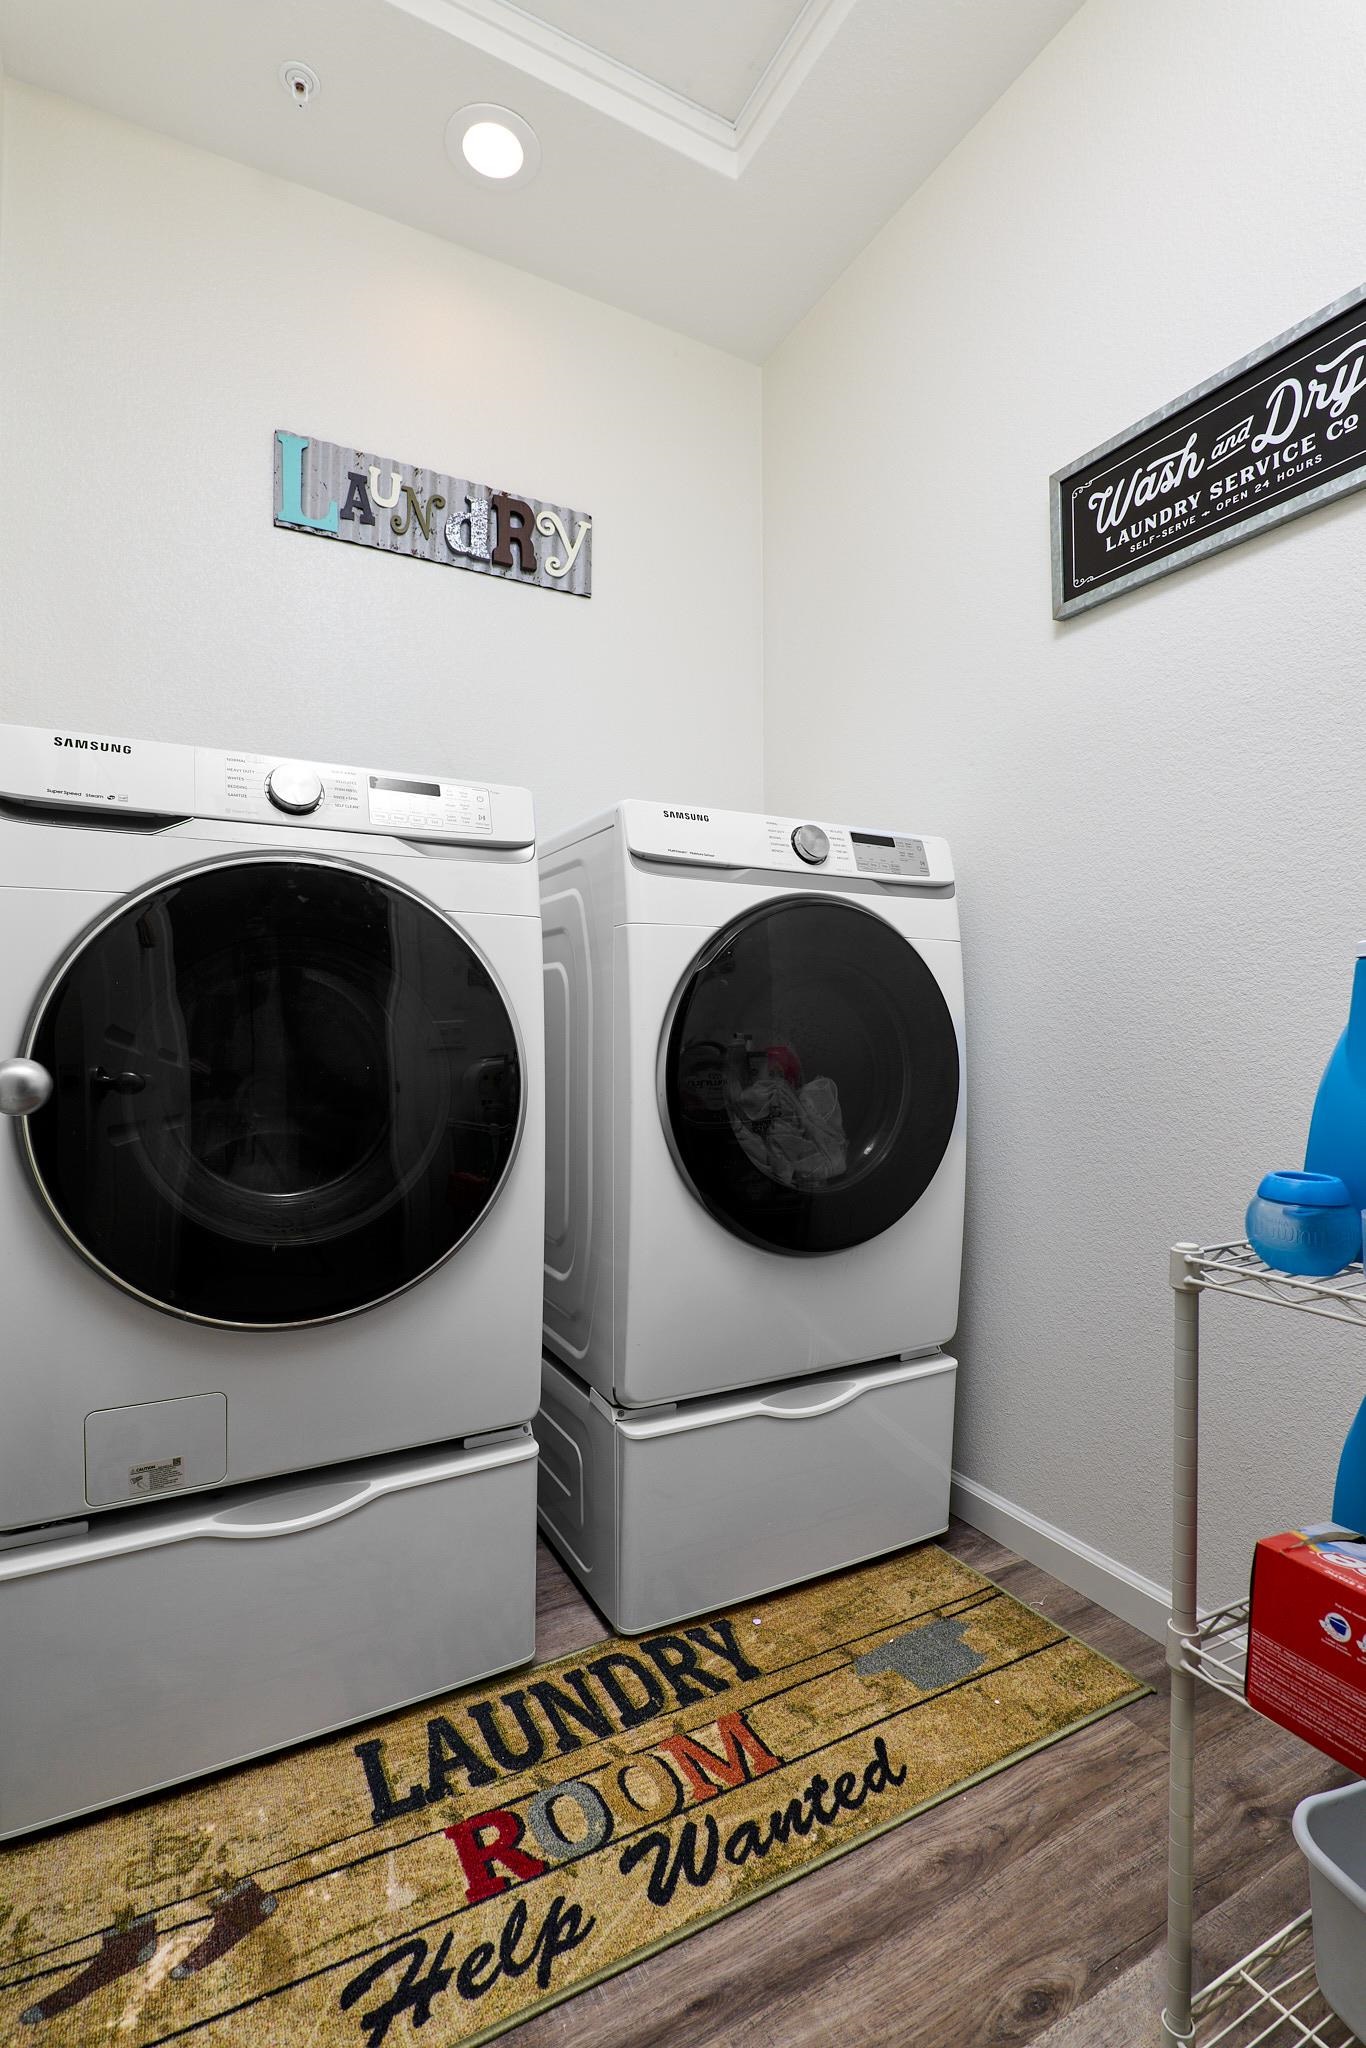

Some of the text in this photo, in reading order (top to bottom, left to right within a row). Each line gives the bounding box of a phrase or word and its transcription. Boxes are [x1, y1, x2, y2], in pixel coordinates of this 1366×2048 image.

[1088, 339, 1366, 534] Wash and Dry
[1105, 491, 1202, 552] LAUNDRY
[1209, 433, 1316, 501] SERVICE
[1129, 453, 1323, 553] SELF-SERVE OPEN 24 HOURS
[53, 736, 132, 754] SAMSUNG
[663, 810, 710, 822] SAMSUNG
[354, 1619, 761, 1825] LAUNDRY
[443, 1710, 785, 1904] ROOM
[339, 1736, 908, 2048] Help Wanted
